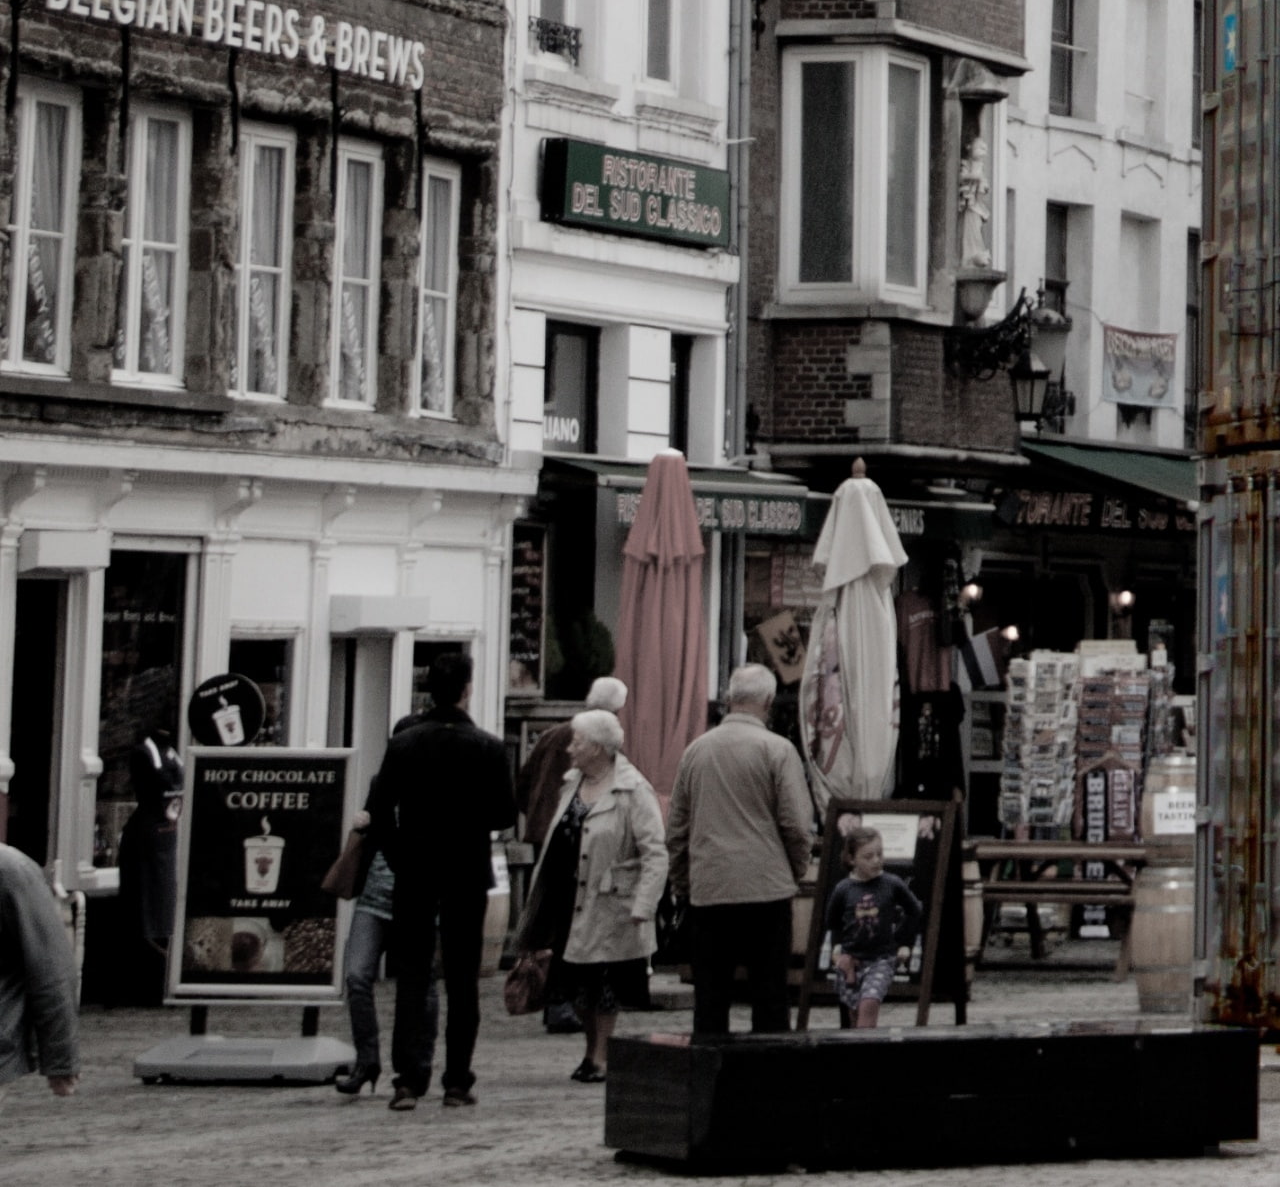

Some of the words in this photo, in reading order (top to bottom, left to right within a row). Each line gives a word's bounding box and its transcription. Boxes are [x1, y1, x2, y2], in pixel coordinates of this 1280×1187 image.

[307, 14, 327, 66] &
[333, 21, 425, 90] BREWS
[602, 154, 697, 201] RISTORANTE
[571, 181, 604, 217] DEL
[609, 189, 642, 222] SUD
[646, 194, 722, 237] CLASSICO
[721, 498, 745, 529] SUD
[748, 499, 802, 531] CLASSICO
[1101, 494, 1133, 529] DEL
[203, 769, 239, 783] HOT
[240, 770, 337, 785] CHOCOLATE
[226, 790, 311, 810] COFFEE
